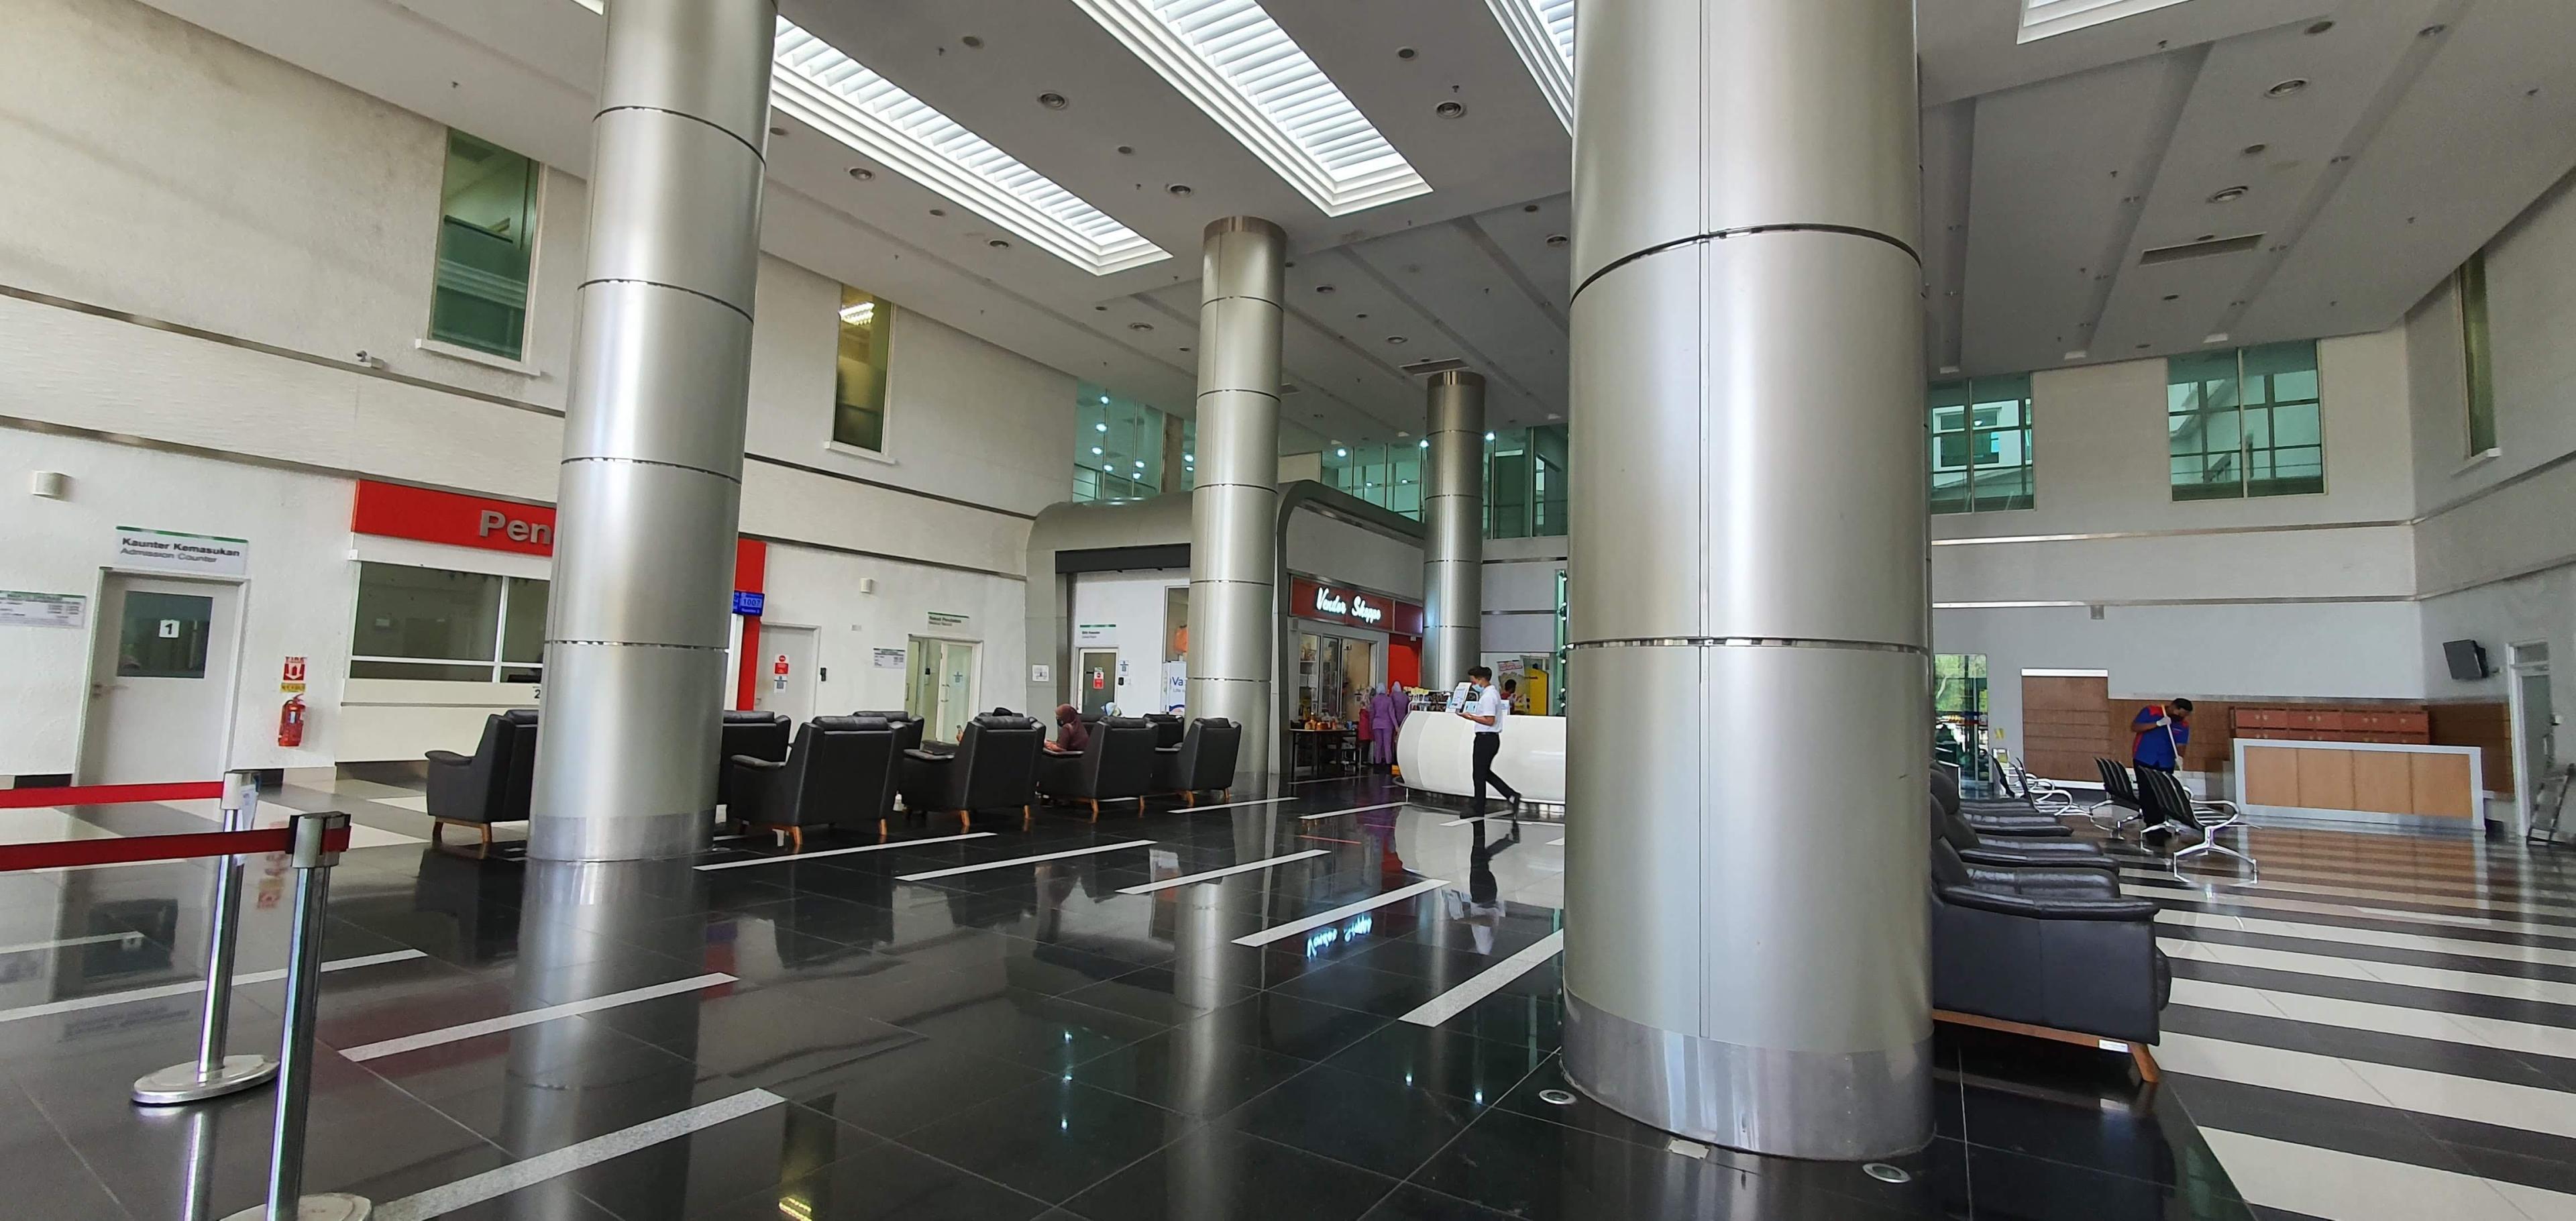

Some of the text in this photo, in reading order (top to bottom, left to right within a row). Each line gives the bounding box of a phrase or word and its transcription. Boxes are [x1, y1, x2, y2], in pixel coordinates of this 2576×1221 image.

[122, 537, 240, 557] Kaunter Kemasukan
[120, 547, 217, 563] Admission Counter
[743, 598, 761, 606] 1007
[164, 623, 172, 635] 1
[533, 688, 541, 699] 2
